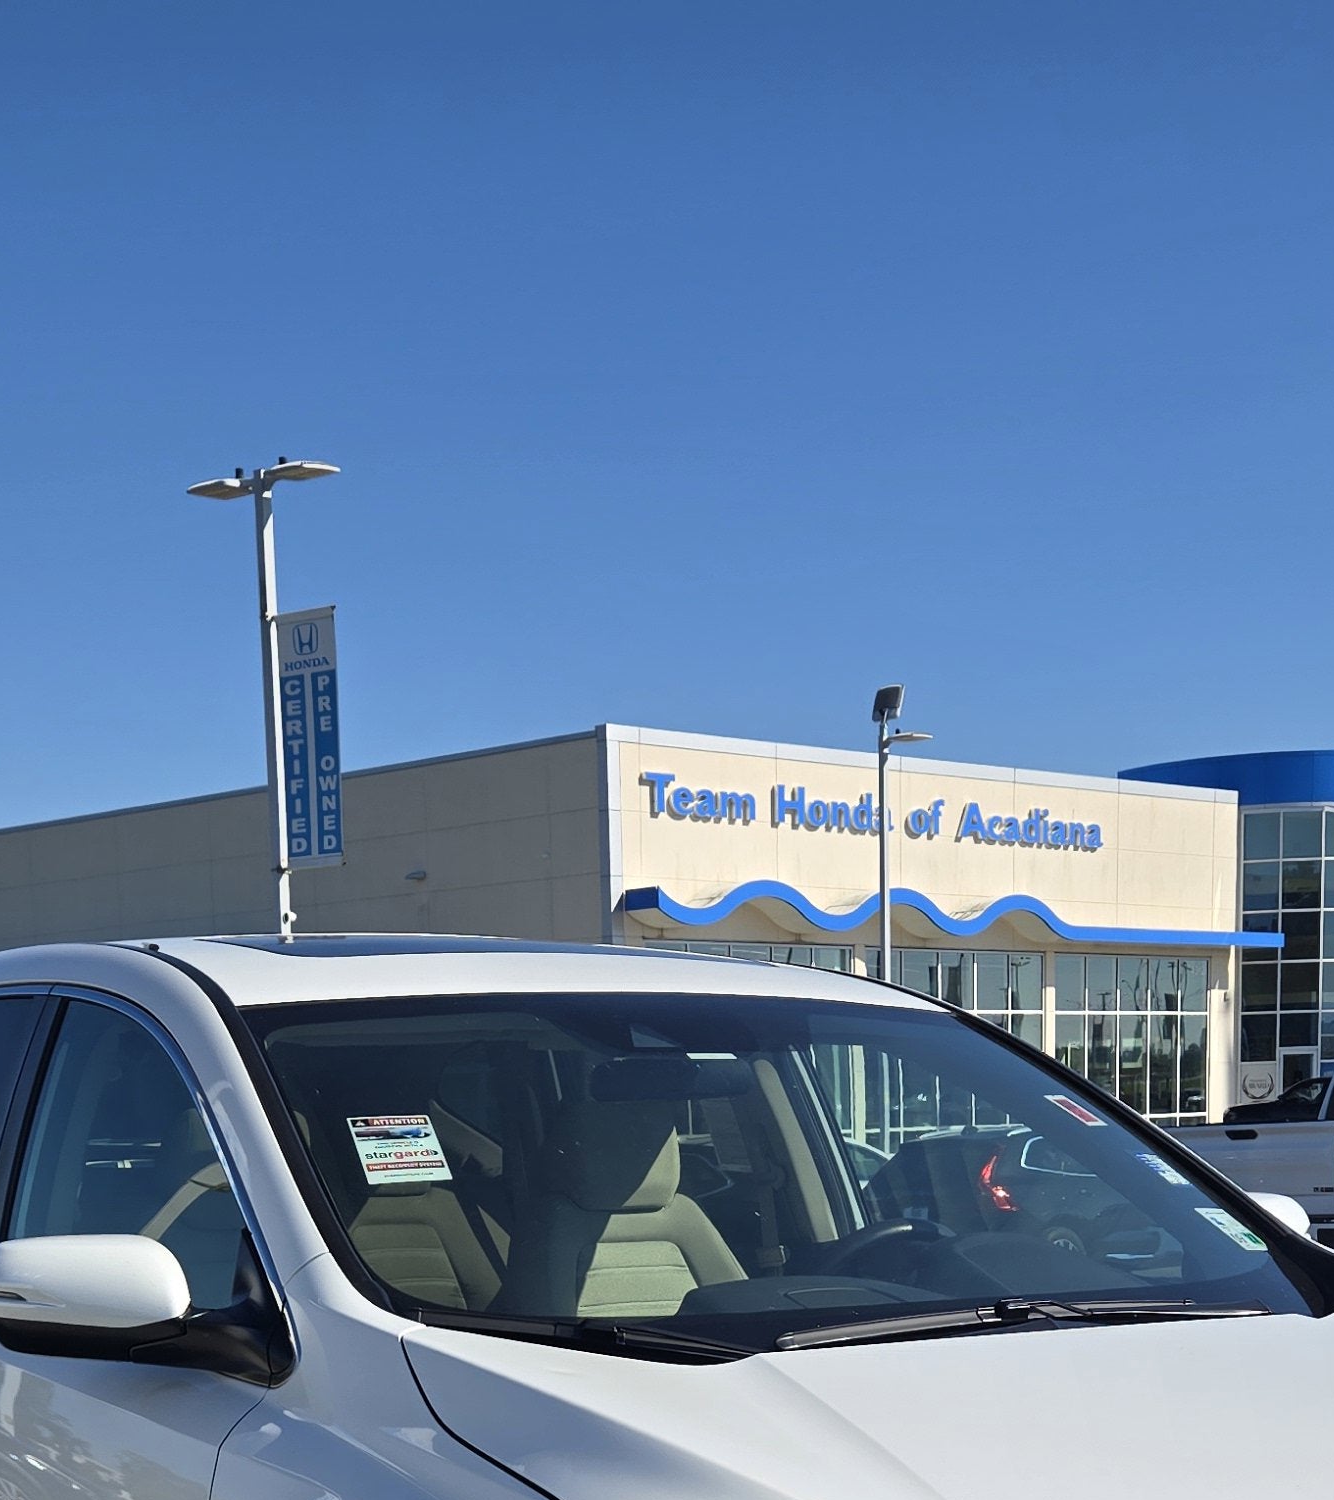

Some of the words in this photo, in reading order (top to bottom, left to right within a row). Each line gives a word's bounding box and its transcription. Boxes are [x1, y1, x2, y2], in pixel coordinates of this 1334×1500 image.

[284, 656, 330, 671] HONDA
[316, 674, 333, 733] PRE
[284, 680, 307, 853] CERTIFIED
[318, 755, 338, 851] OWNED
[642, 771, 757, 823] Team
[772, 784, 895, 833] Honda
[907, 798, 946, 838] of
[957, 801, 1105, 850] Acadiana
[373, 1117, 426, 1127] ATTENTION
